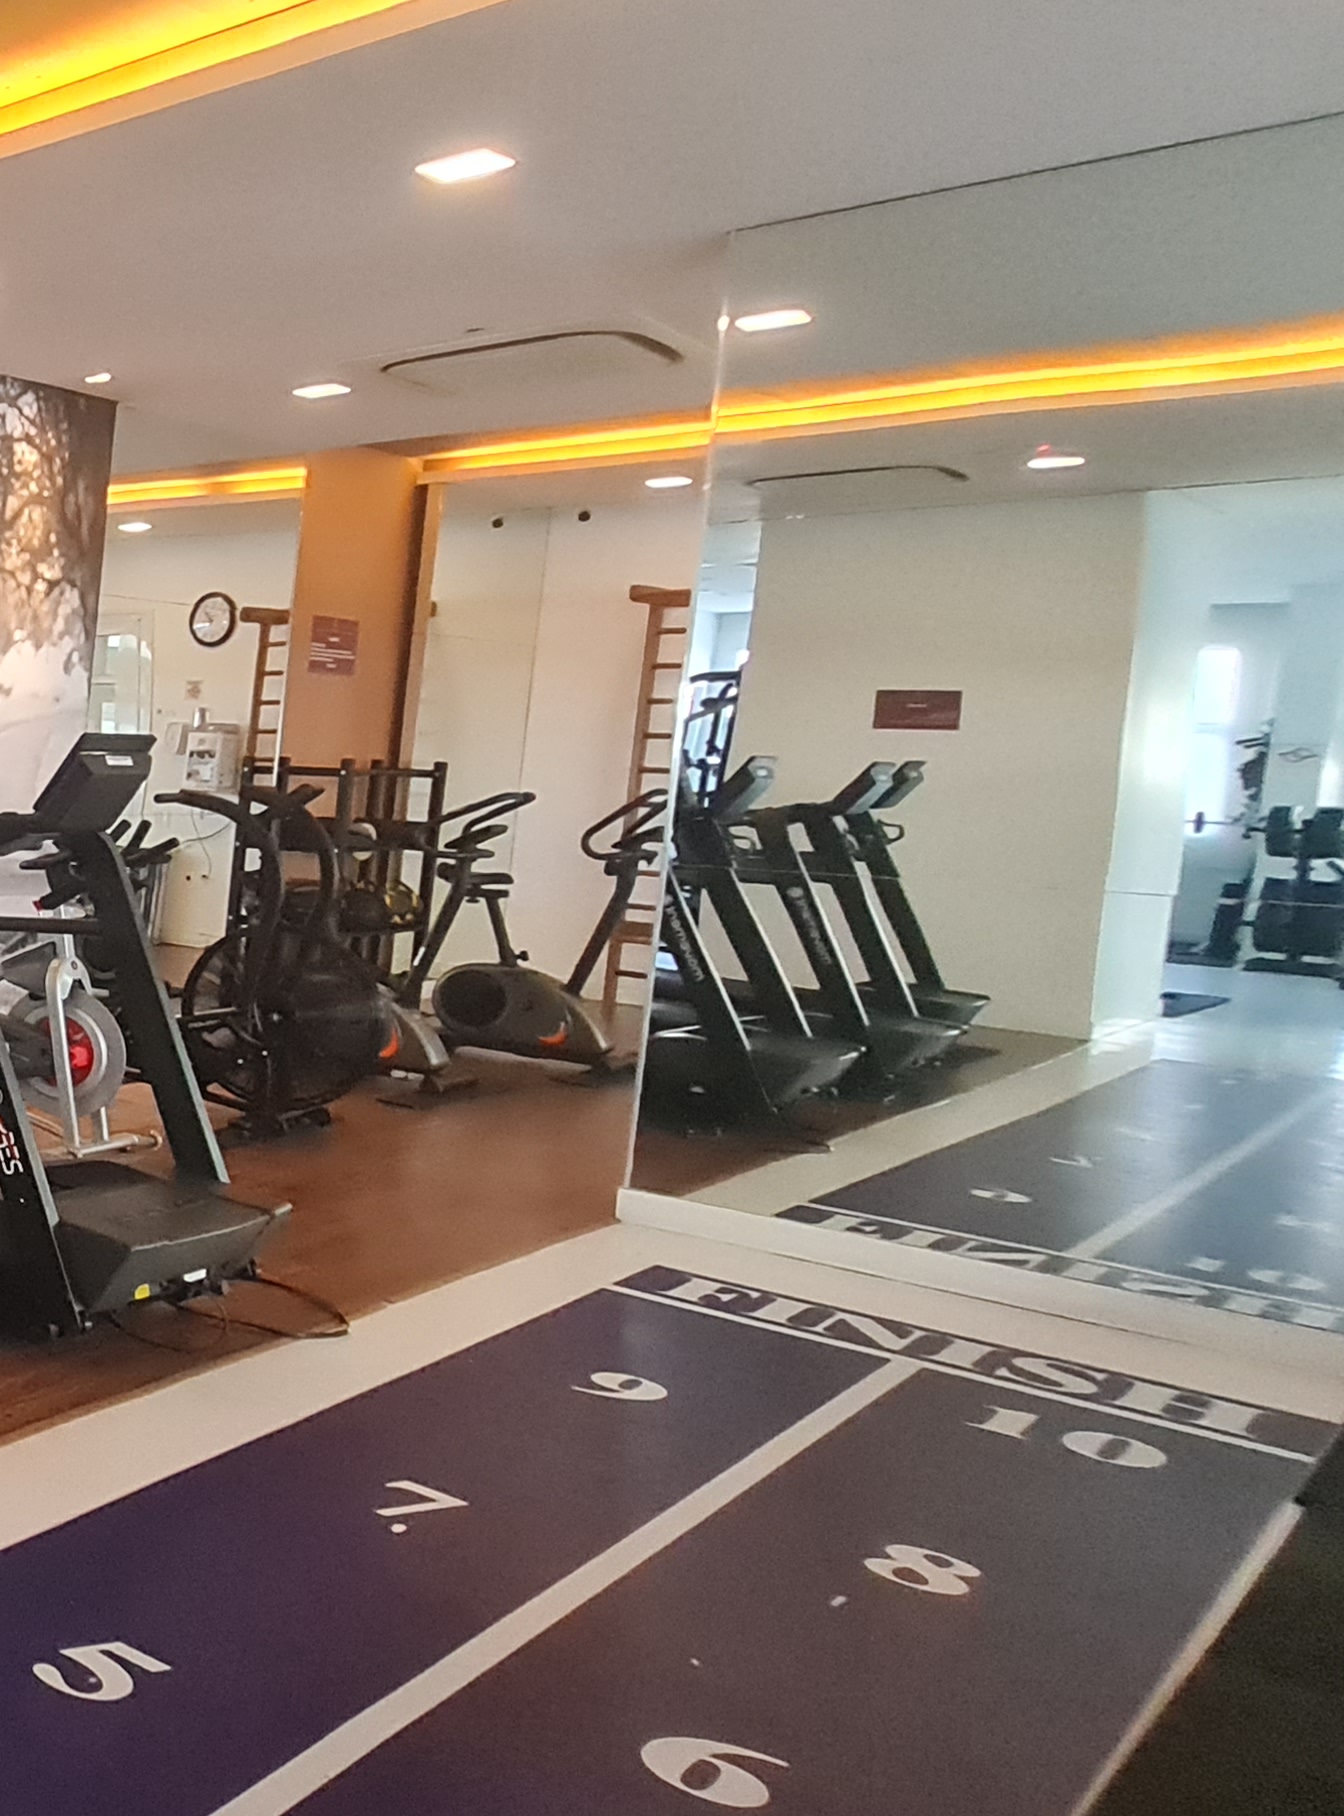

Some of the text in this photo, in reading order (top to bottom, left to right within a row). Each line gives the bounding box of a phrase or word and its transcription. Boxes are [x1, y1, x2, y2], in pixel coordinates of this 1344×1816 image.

[570, 1371, 670, 1402] 9
[666, 1276, 1269, 1439] FINISH
[964, 1405, 1168, 1470] 10
[863, 1544, 982, 1597] 8
[32, 1641, 173, 1702] 5
[639, 1736, 791, 1809] 6
